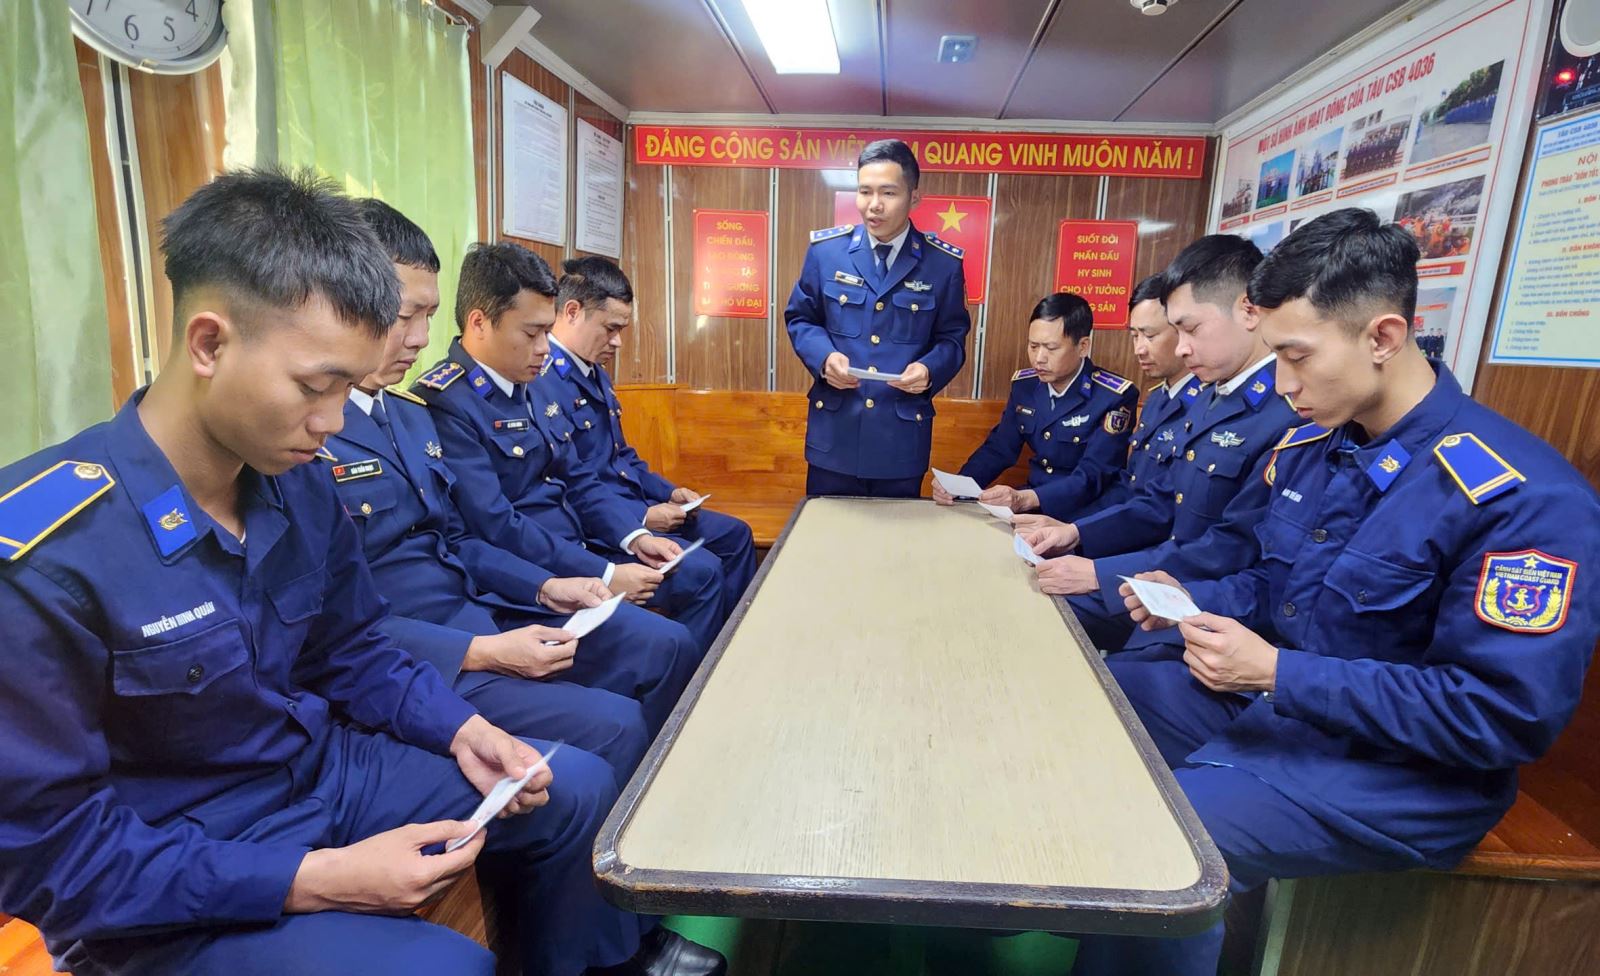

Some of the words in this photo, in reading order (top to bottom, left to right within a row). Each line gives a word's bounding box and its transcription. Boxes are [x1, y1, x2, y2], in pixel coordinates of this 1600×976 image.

[185, 0, 199, 22] 4
[124, 14, 140, 41] 6
[163, 16, 176, 42] 5
[1366, 76, 1385, 102] TÀU
[1385, 66, 1407, 93] CSB
[1408, 52, 1436, 82] 4036
[645, 128, 706, 158] ĐẢNG
[711, 132, 774, 164] CỘNG
[779, 132, 821, 160] SẢN
[925, 141, 1003, 166] QUANG
[1009, 143, 1057, 166] VINH
[1063, 139, 1128, 169] MUÔN
[1133, 141, 1183, 170] NĂM
[706, 235, 733, 246] CHIẾN
[1077, 233, 1099, 244] SUỐT
[1101, 234, 1119, 244] ĐỜI
[1073, 249, 1098, 260] PHẤN
[1099, 249, 1120, 260] ĐẤU
[1077, 269, 1090, 277] HY
[1091, 269, 1112, 278] SINH
[1060, 285, 1082, 294] CHO
[1094, 284, 1127, 295] TƯỞNG
[746, 298, 763, 309] ĐẠI
[1097, 300, 1116, 312] SẢN
[141, 615, 178, 638] NGUYỄN
